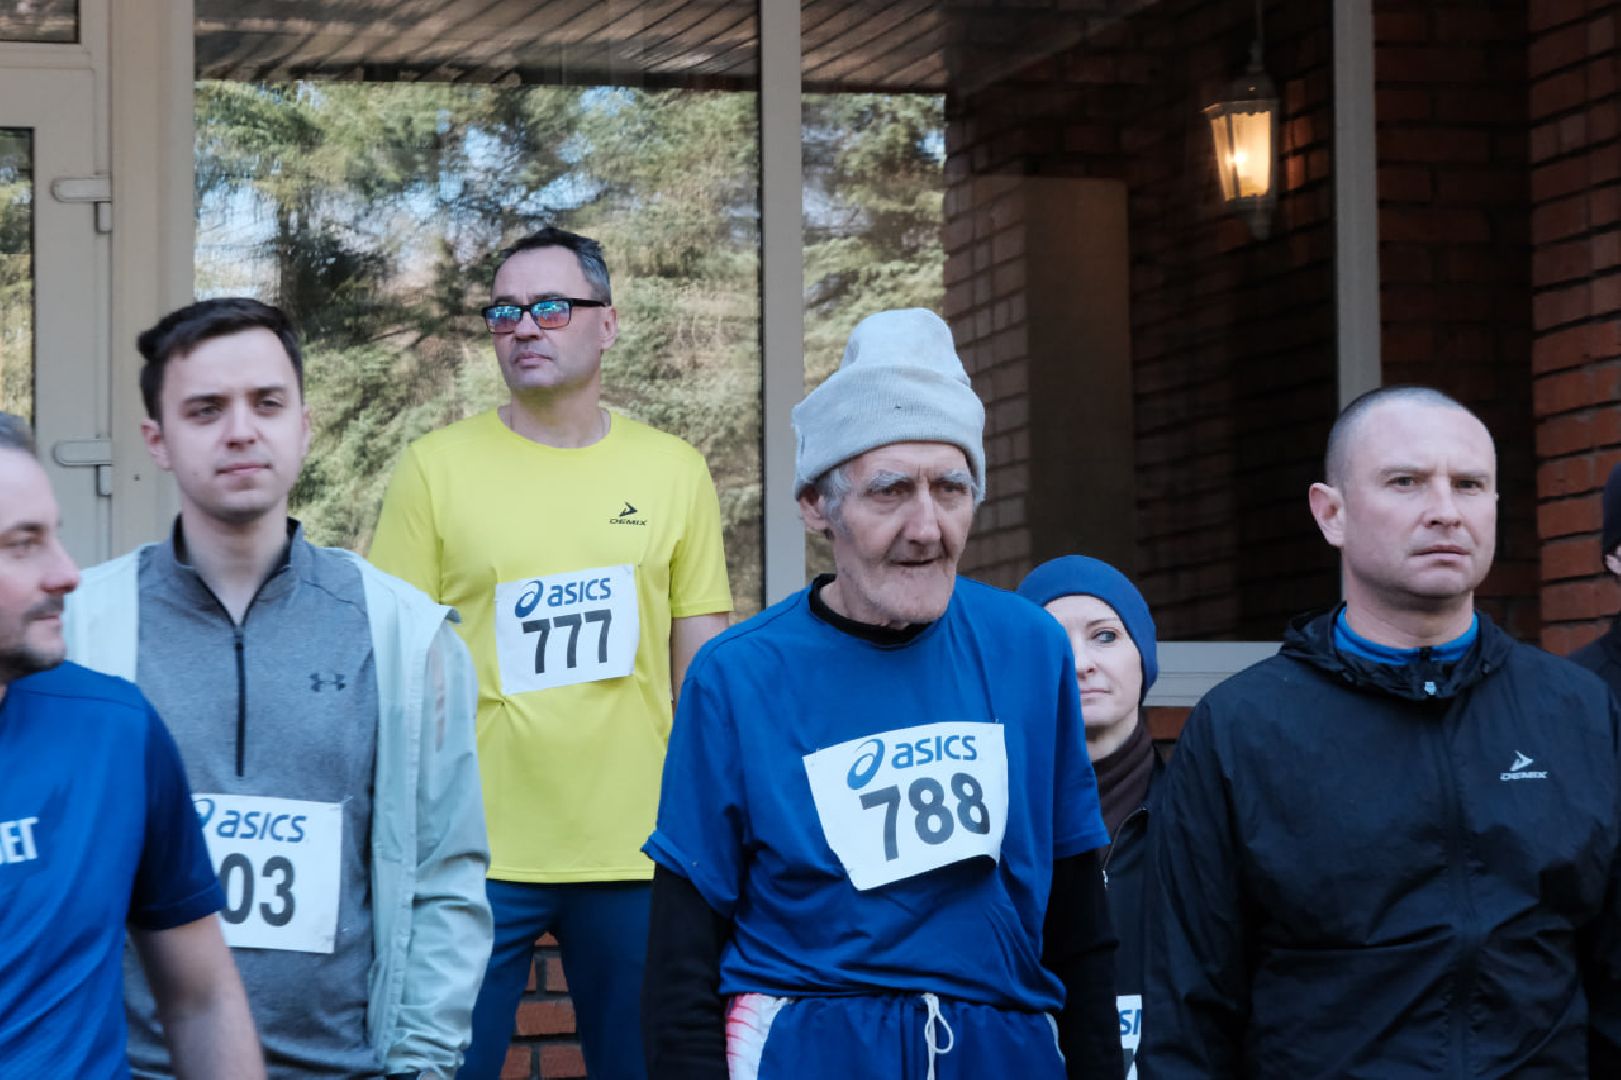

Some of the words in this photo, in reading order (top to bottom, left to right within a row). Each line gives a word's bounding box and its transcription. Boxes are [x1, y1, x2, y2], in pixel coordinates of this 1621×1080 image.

[521, 609, 612, 674] 777
[859, 773, 991, 862] 788
[220, 853, 296, 927] 03
